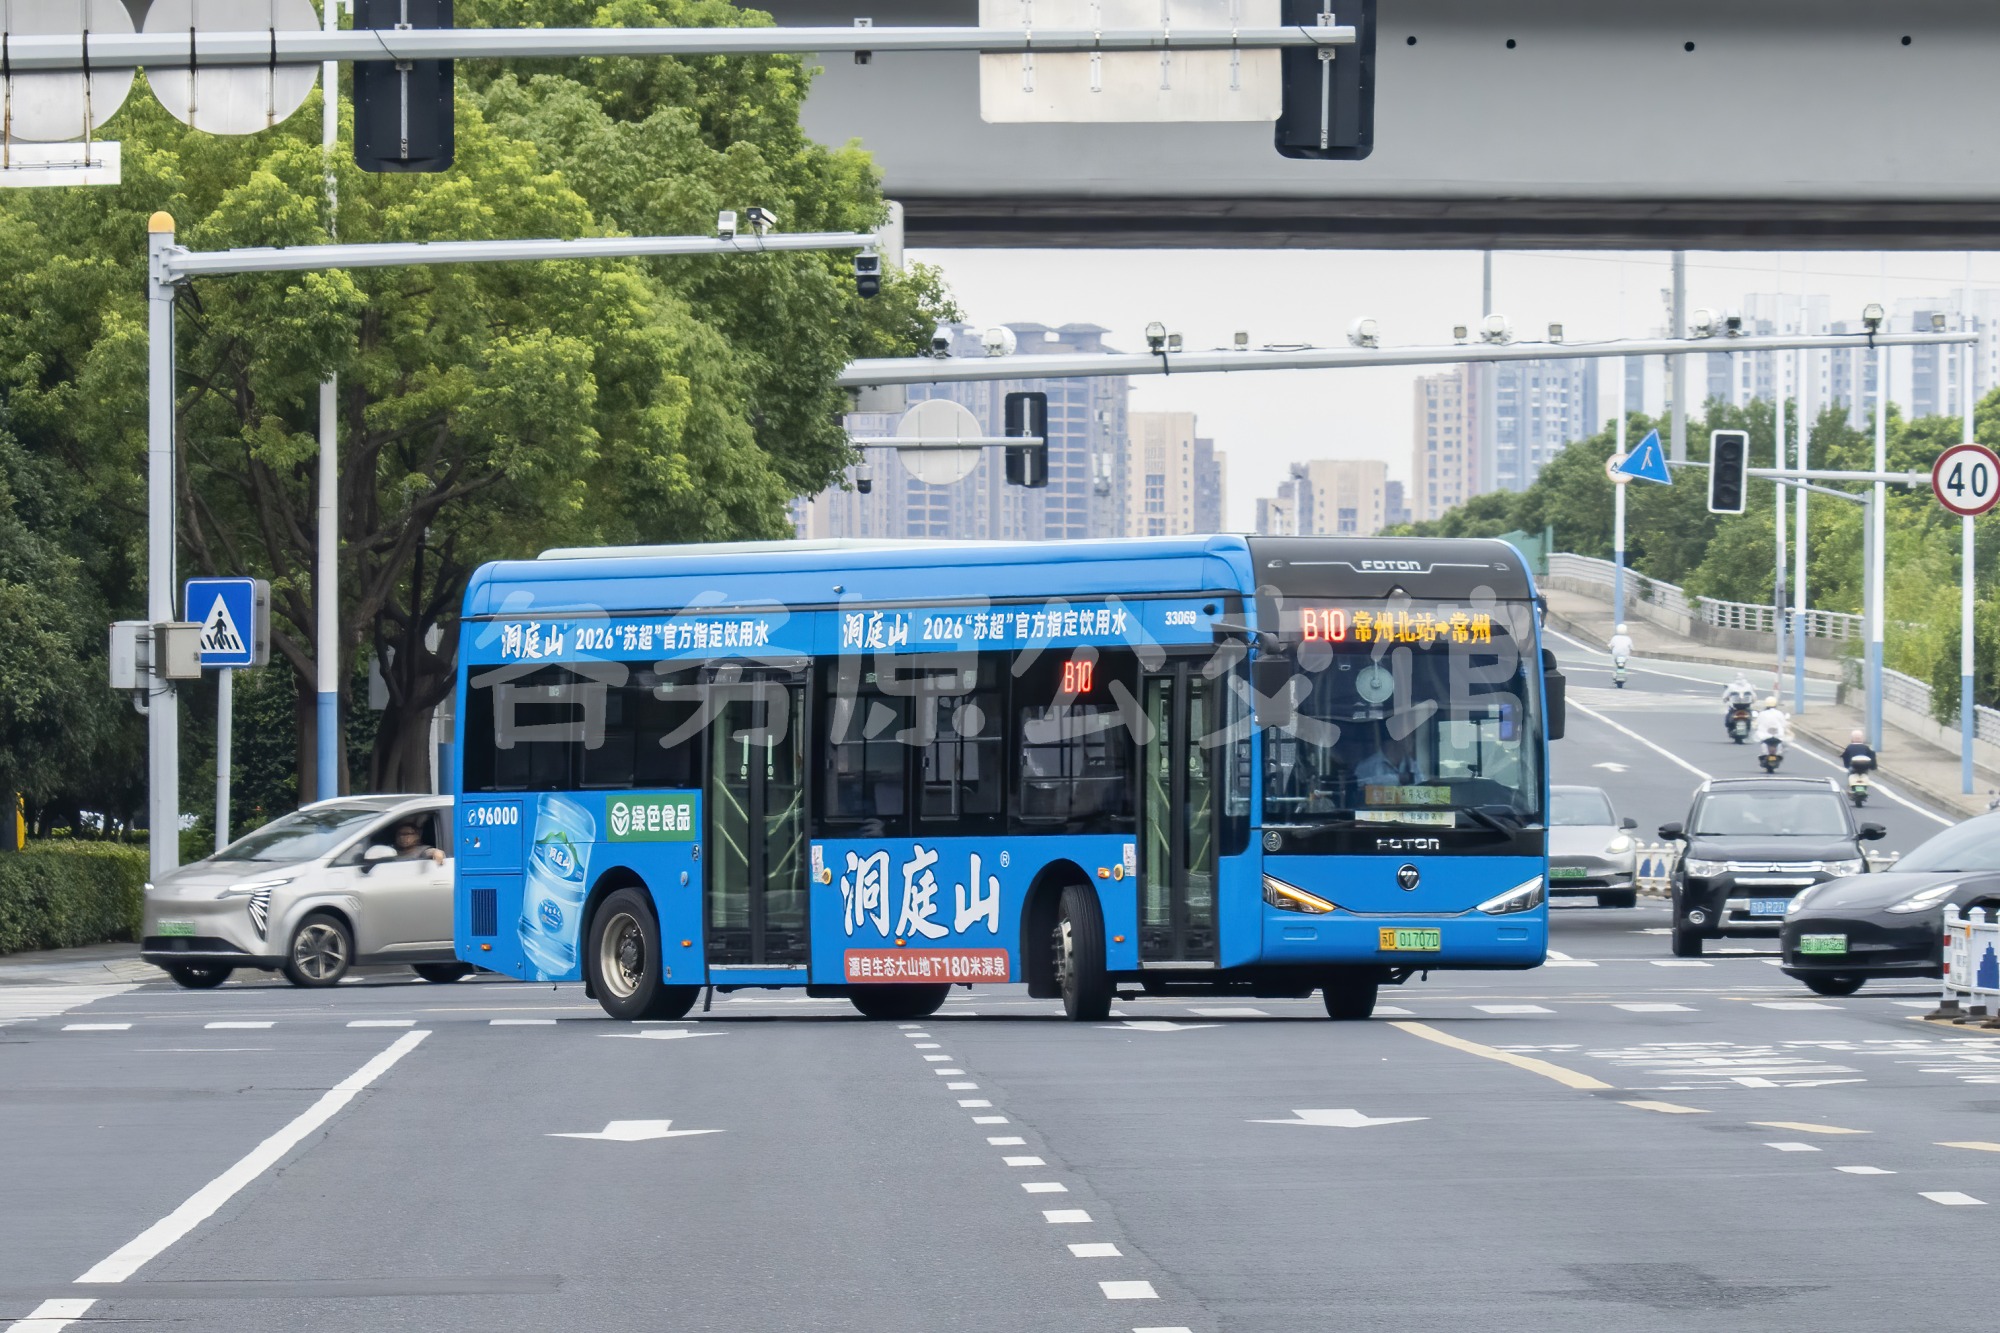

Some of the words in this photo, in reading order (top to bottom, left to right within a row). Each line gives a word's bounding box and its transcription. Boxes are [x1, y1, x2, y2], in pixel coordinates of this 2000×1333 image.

[1947, 462, 1988, 497] 40
[1361, 560, 1421, 571] FOTON
[843, 610, 908, 648] 洞庭山
[1165, 611, 1197, 625] 33069
[1303, 608, 1347, 642] B10
[501, 621, 564, 659] 洞庭山
[1064, 661, 1093, 693] B10
[478, 806, 519, 826] 96000
[631, 804, 691, 832] 绿色食品
[1376, 838, 1440, 850] FOTON
[840, 844, 1001, 939] 洞庭山
[848, 956, 1006, 977] 源自生态大山地下180米深泉
